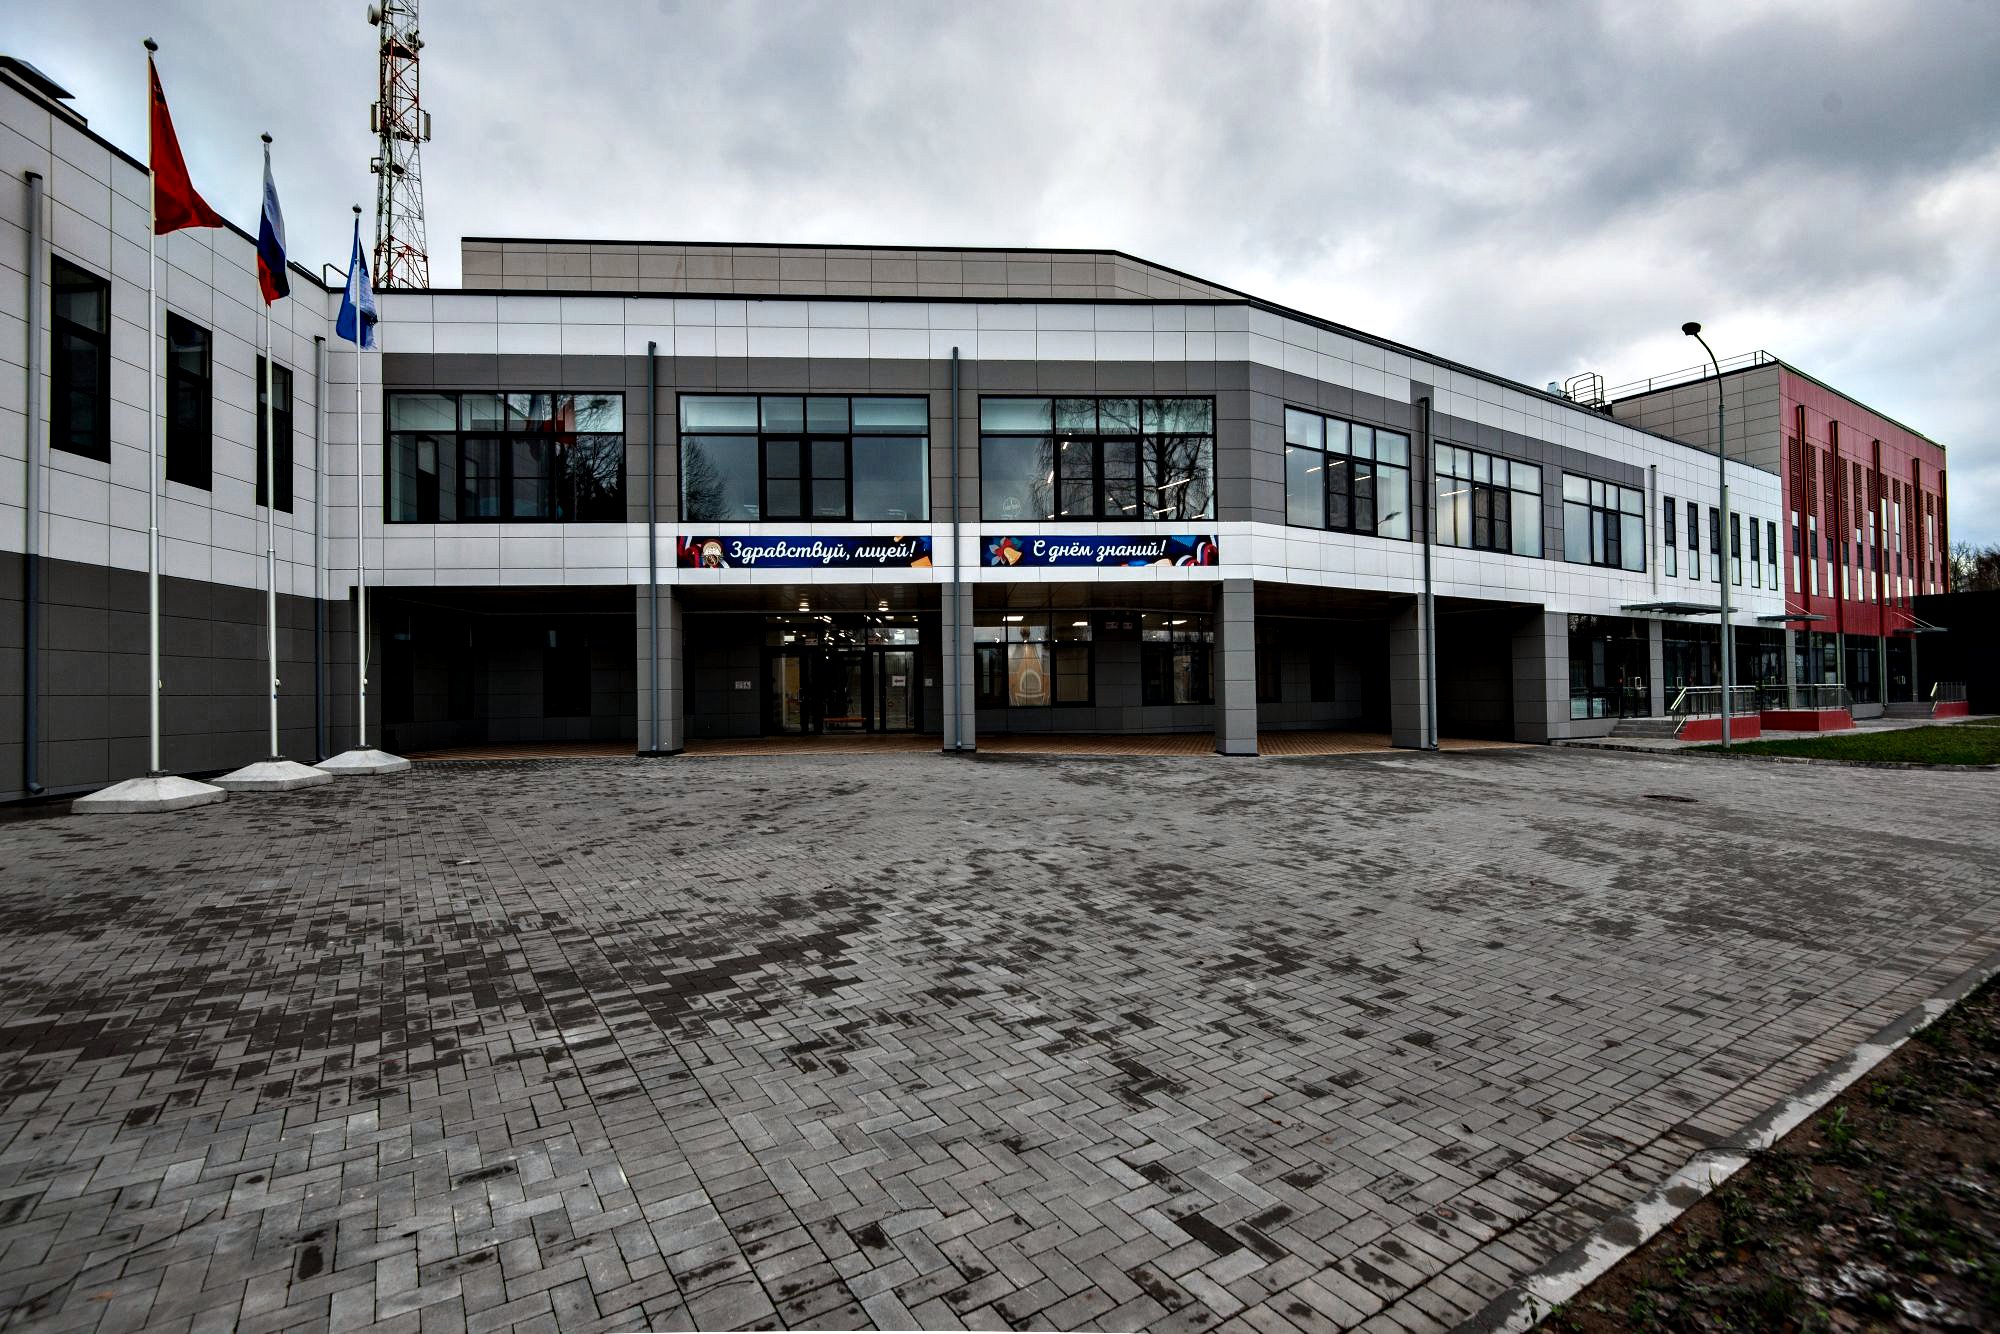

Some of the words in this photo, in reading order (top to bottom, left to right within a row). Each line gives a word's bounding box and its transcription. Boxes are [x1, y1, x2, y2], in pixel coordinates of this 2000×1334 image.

[730, 541, 850, 564] Здравствуй,
[855, 541, 917, 562] лицей!
[1033, 540, 1046, 557] С
[1048, 543, 1094, 563] днём
[1096, 540, 1167, 562] знаний!
